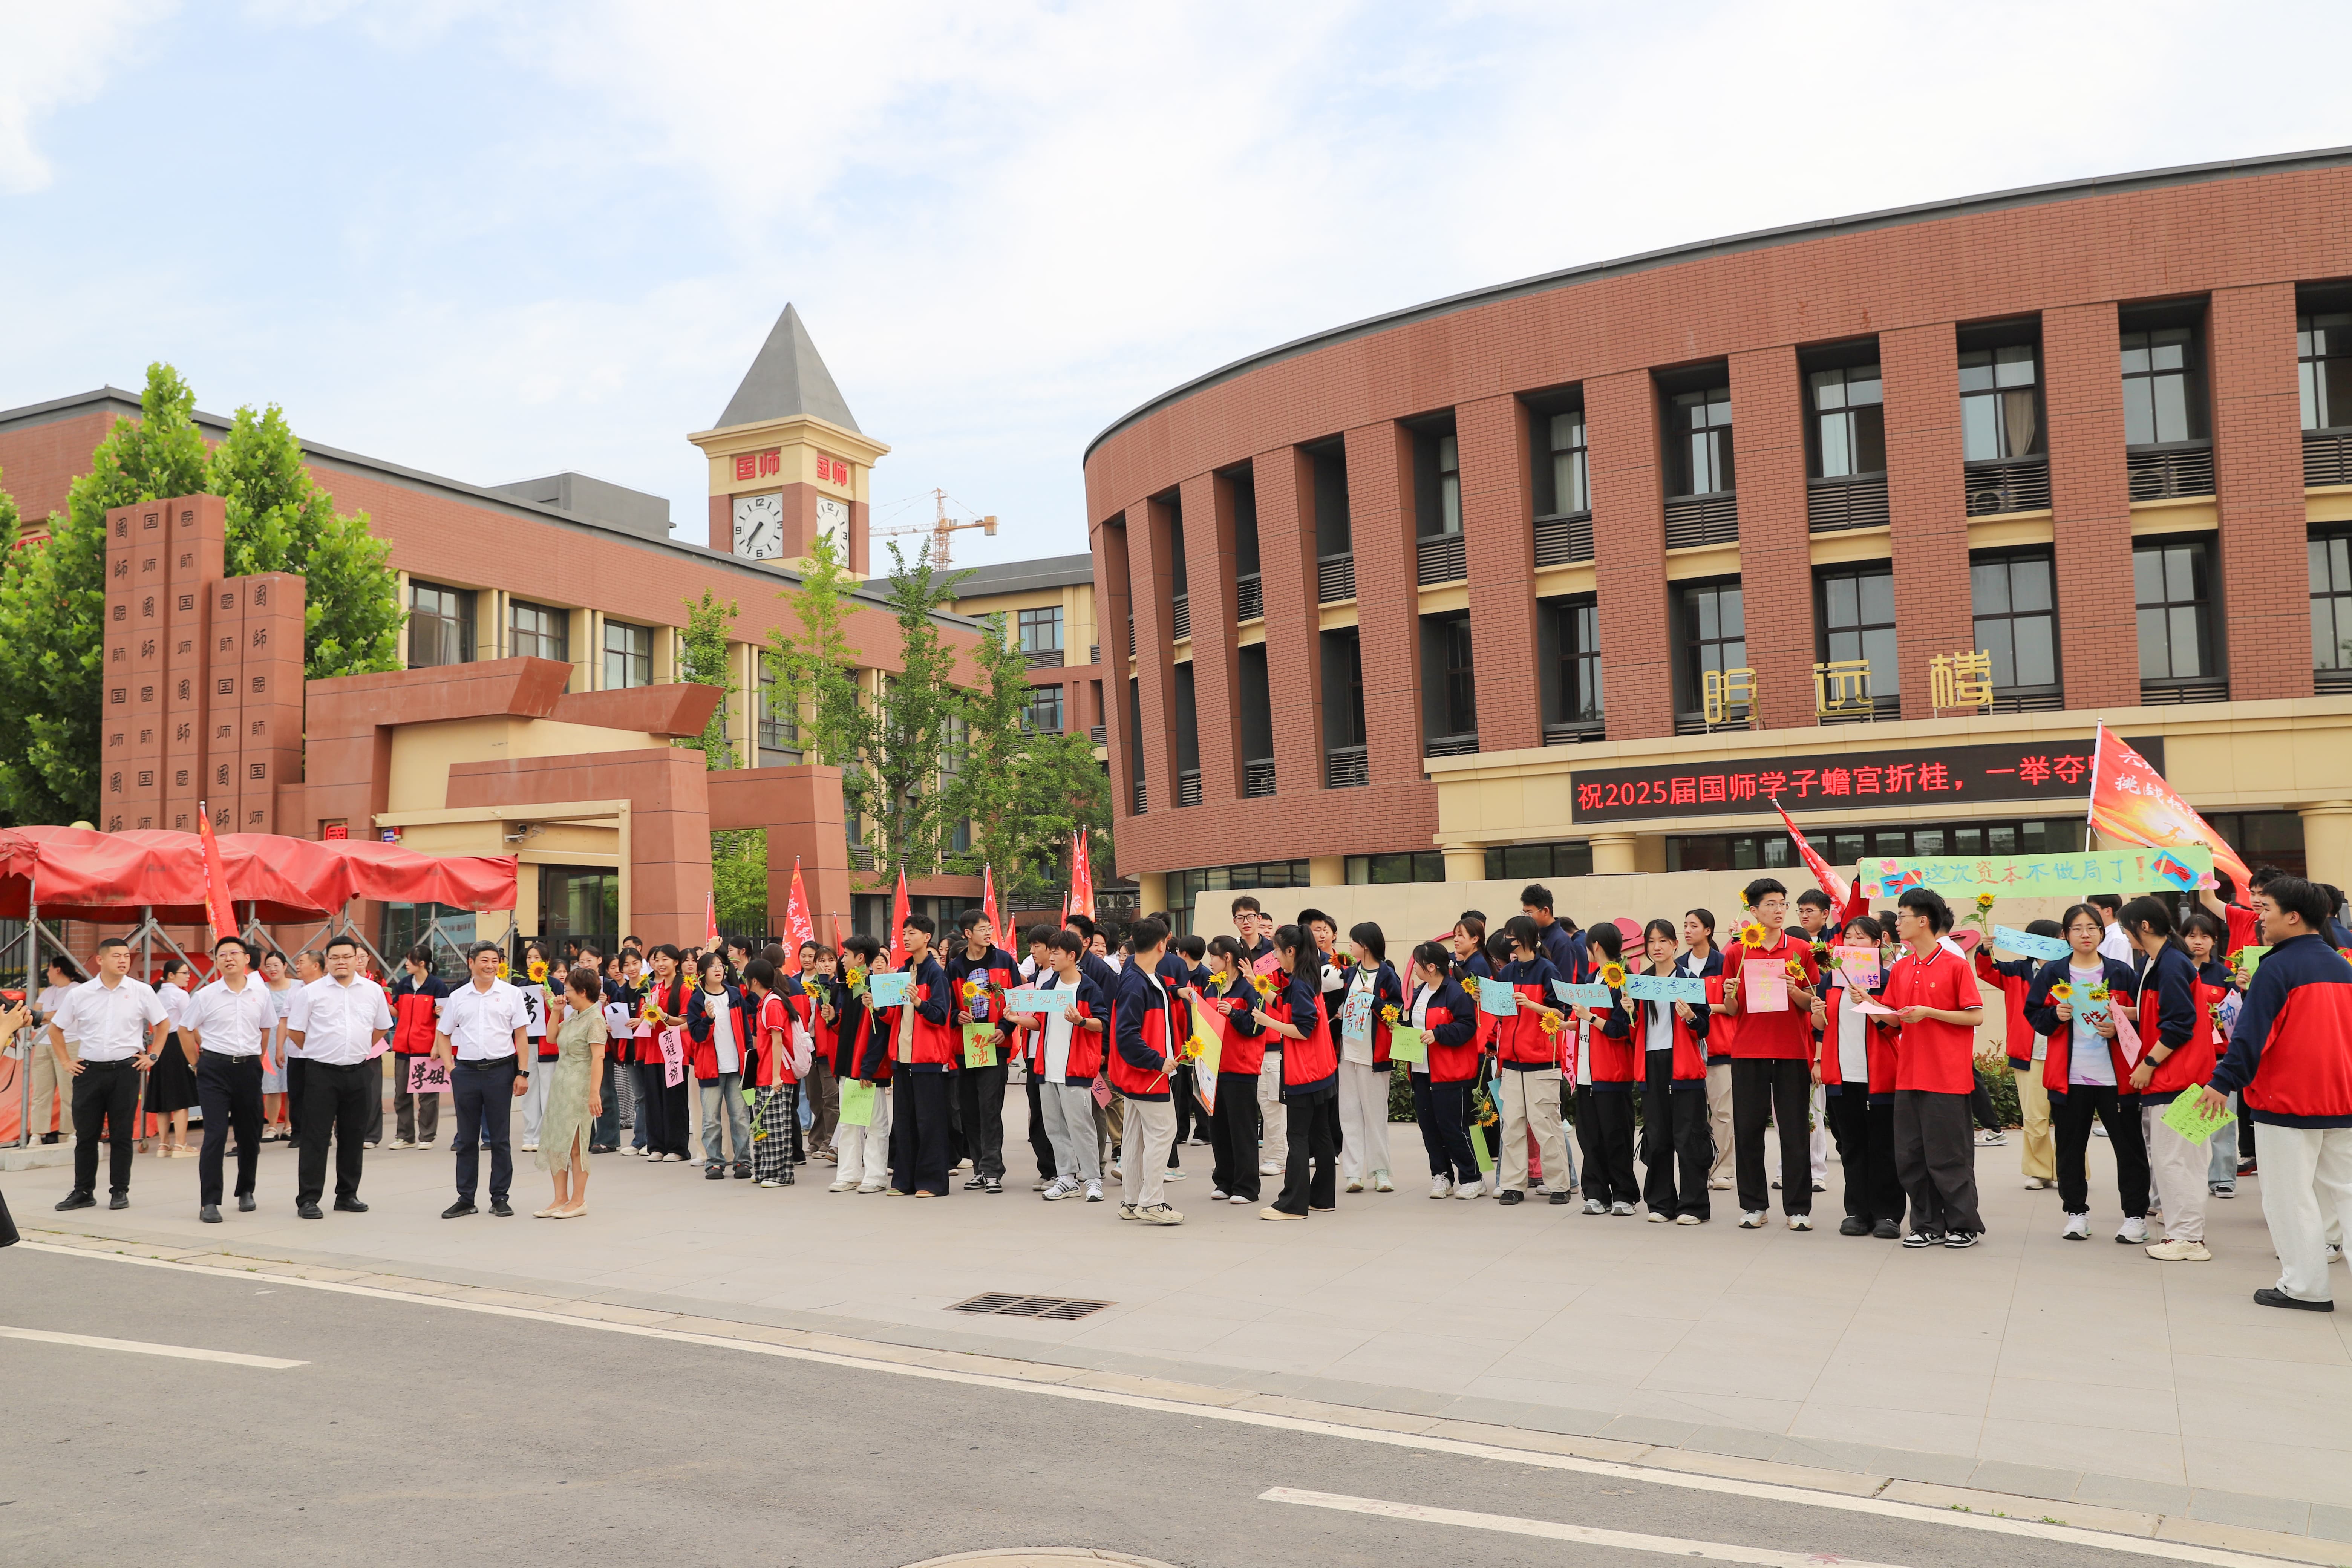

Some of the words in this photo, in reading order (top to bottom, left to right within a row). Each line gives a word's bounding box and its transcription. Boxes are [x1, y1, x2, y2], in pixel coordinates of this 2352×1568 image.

[737, 450, 780, 480] 国师
[818, 454, 848, 487] 国师
[756, 498, 764, 507] 12
[828, 503, 834, 511] 12
[1703, 649, 1993, 723] 明远楼
[1578, 754, 2095, 810] 祝2025届国师学子蟾宫折桂，一举夺
[1009, 991, 1069, 1008] 高考必胜
[663, 1030, 679, 1083] 前程似锦
[411, 1061, 450, 1090] 学姐
